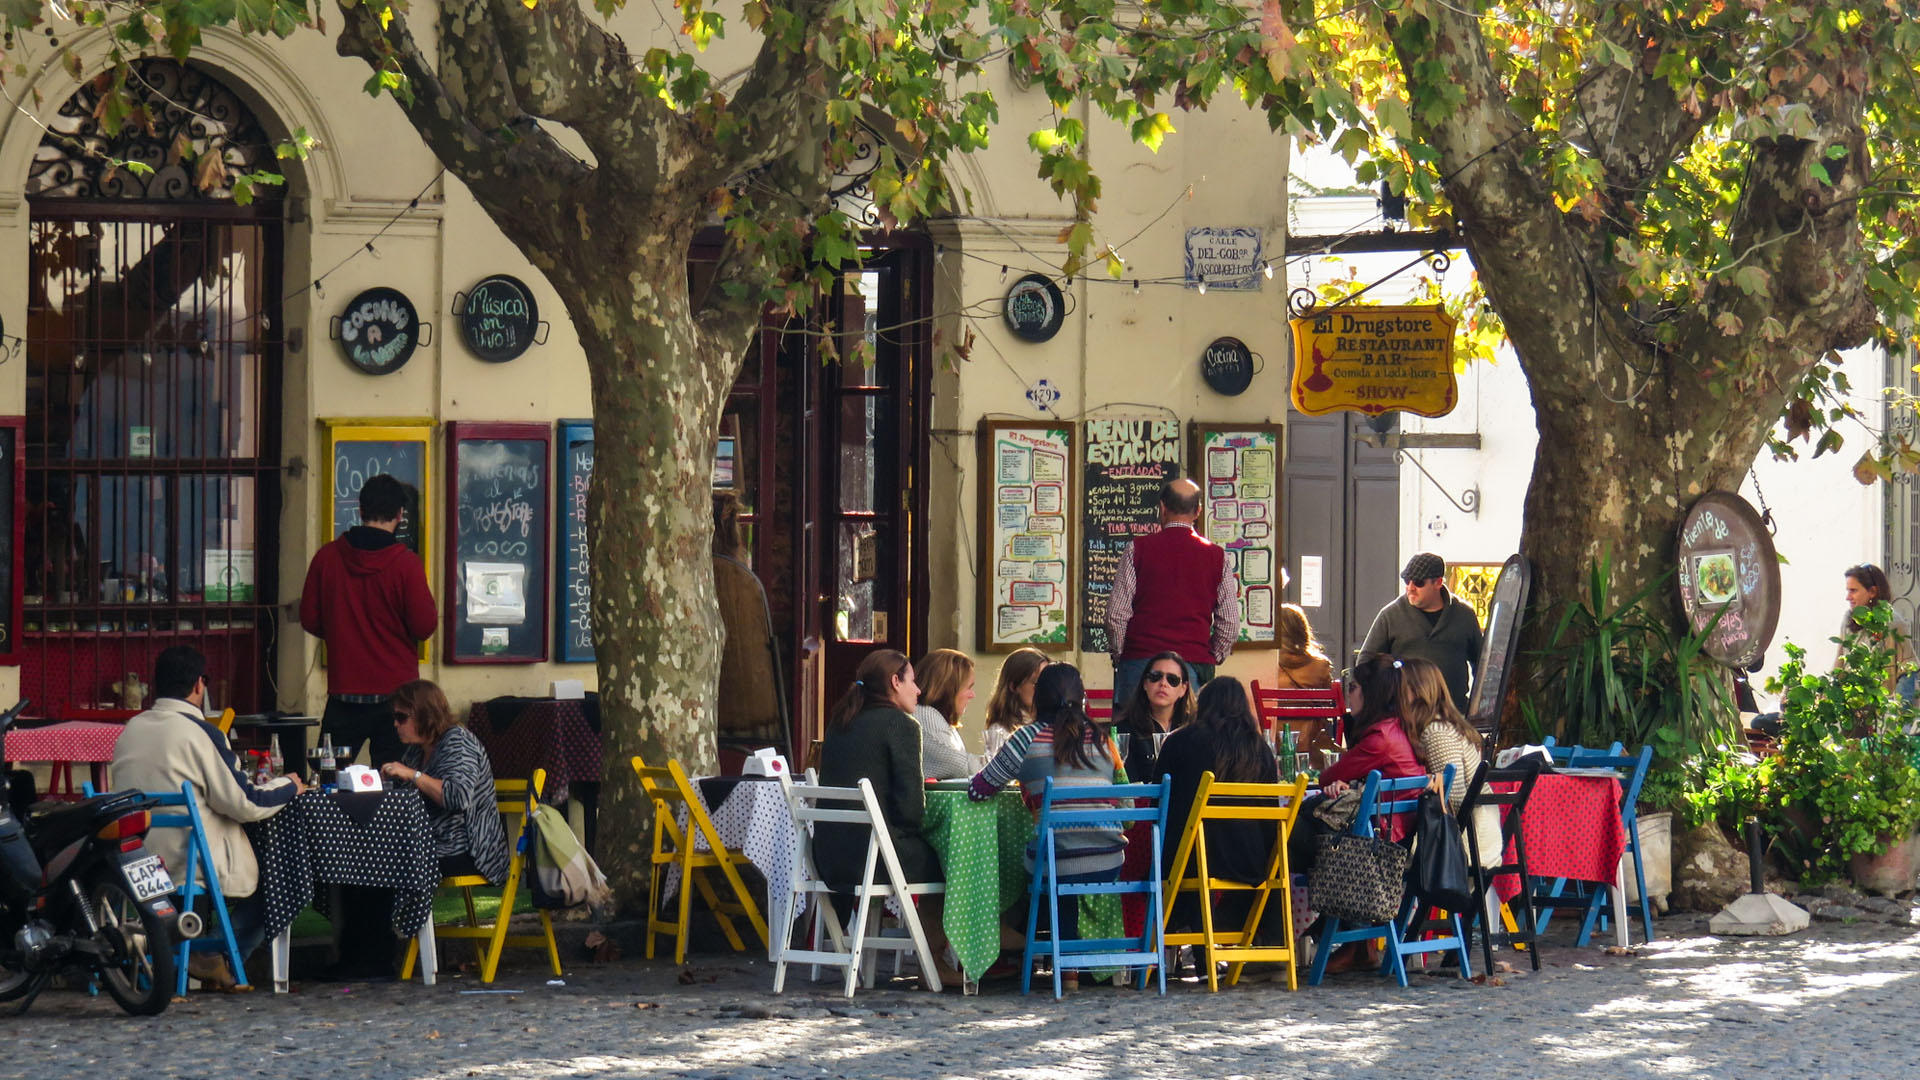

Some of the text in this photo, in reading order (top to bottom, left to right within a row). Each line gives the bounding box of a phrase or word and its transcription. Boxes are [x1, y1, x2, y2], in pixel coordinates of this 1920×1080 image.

[1209, 238, 1237, 246] CALLE
[468, 287, 527, 316] Música
[367, 324, 383, 345] A
[1312, 314, 1433, 338] El Drugstore
[1336, 336, 1446, 351] RESTAURANT
[1206, 347, 1240, 368] Cocina
[1362, 353, 1402, 366] BAR
[1333, 367, 1438, 379] Comida a toda hora
[1356, 385, 1409, 400] SHOW
[1150, 419, 1180, 442] DE
[1714, 518, 1729, 541] de
[136, 877, 166, 898] 844
